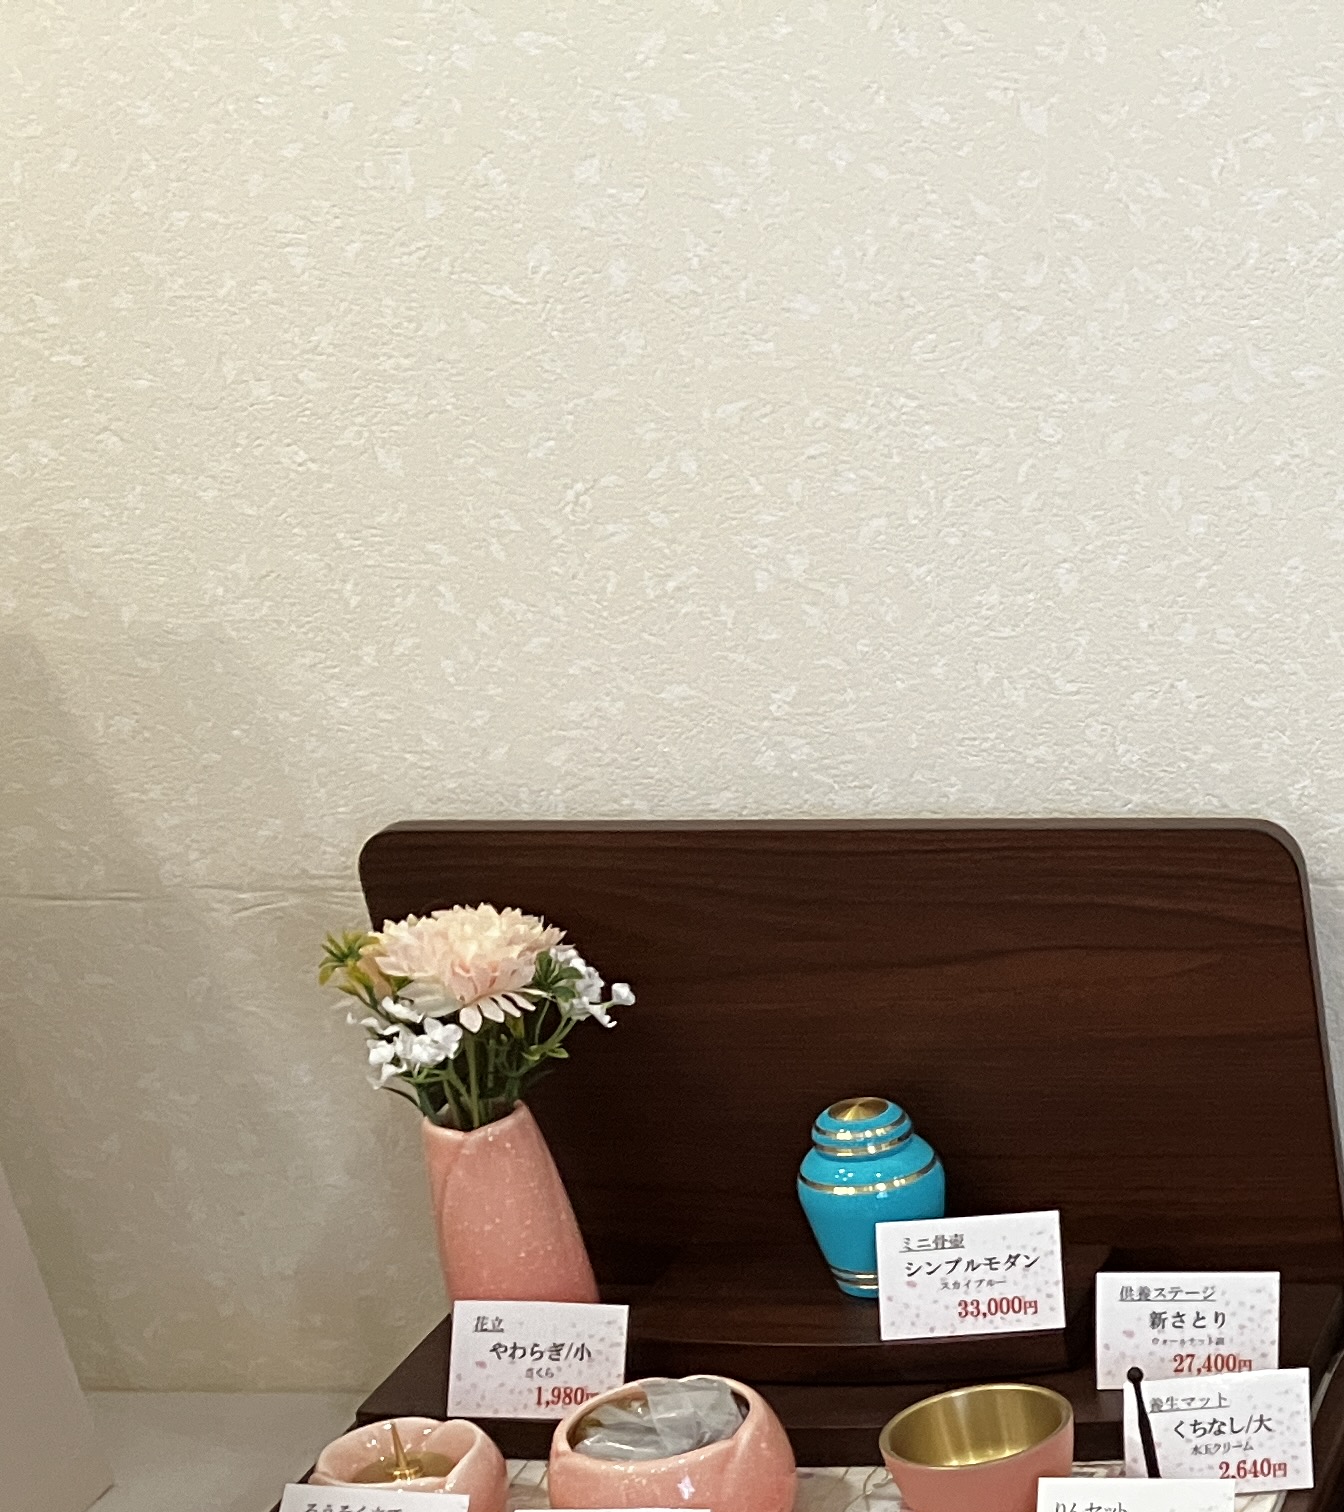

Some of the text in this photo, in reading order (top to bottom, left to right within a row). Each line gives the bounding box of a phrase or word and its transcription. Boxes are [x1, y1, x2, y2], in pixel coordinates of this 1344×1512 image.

[905, 1253, 1040, 1277] シンプルモダン
[957, 1295, 1038, 1319] 33,000円
[1149, 1310, 1226, 1330] 新さとり
[489, 1341, 593, 1362] やわらぎ/小
[1173, 1353, 1253, 1375] 27,400円
[1173, 1413, 1273, 1439] くちなし/大
[1218, 1458, 1288, 1479] 2,640円
